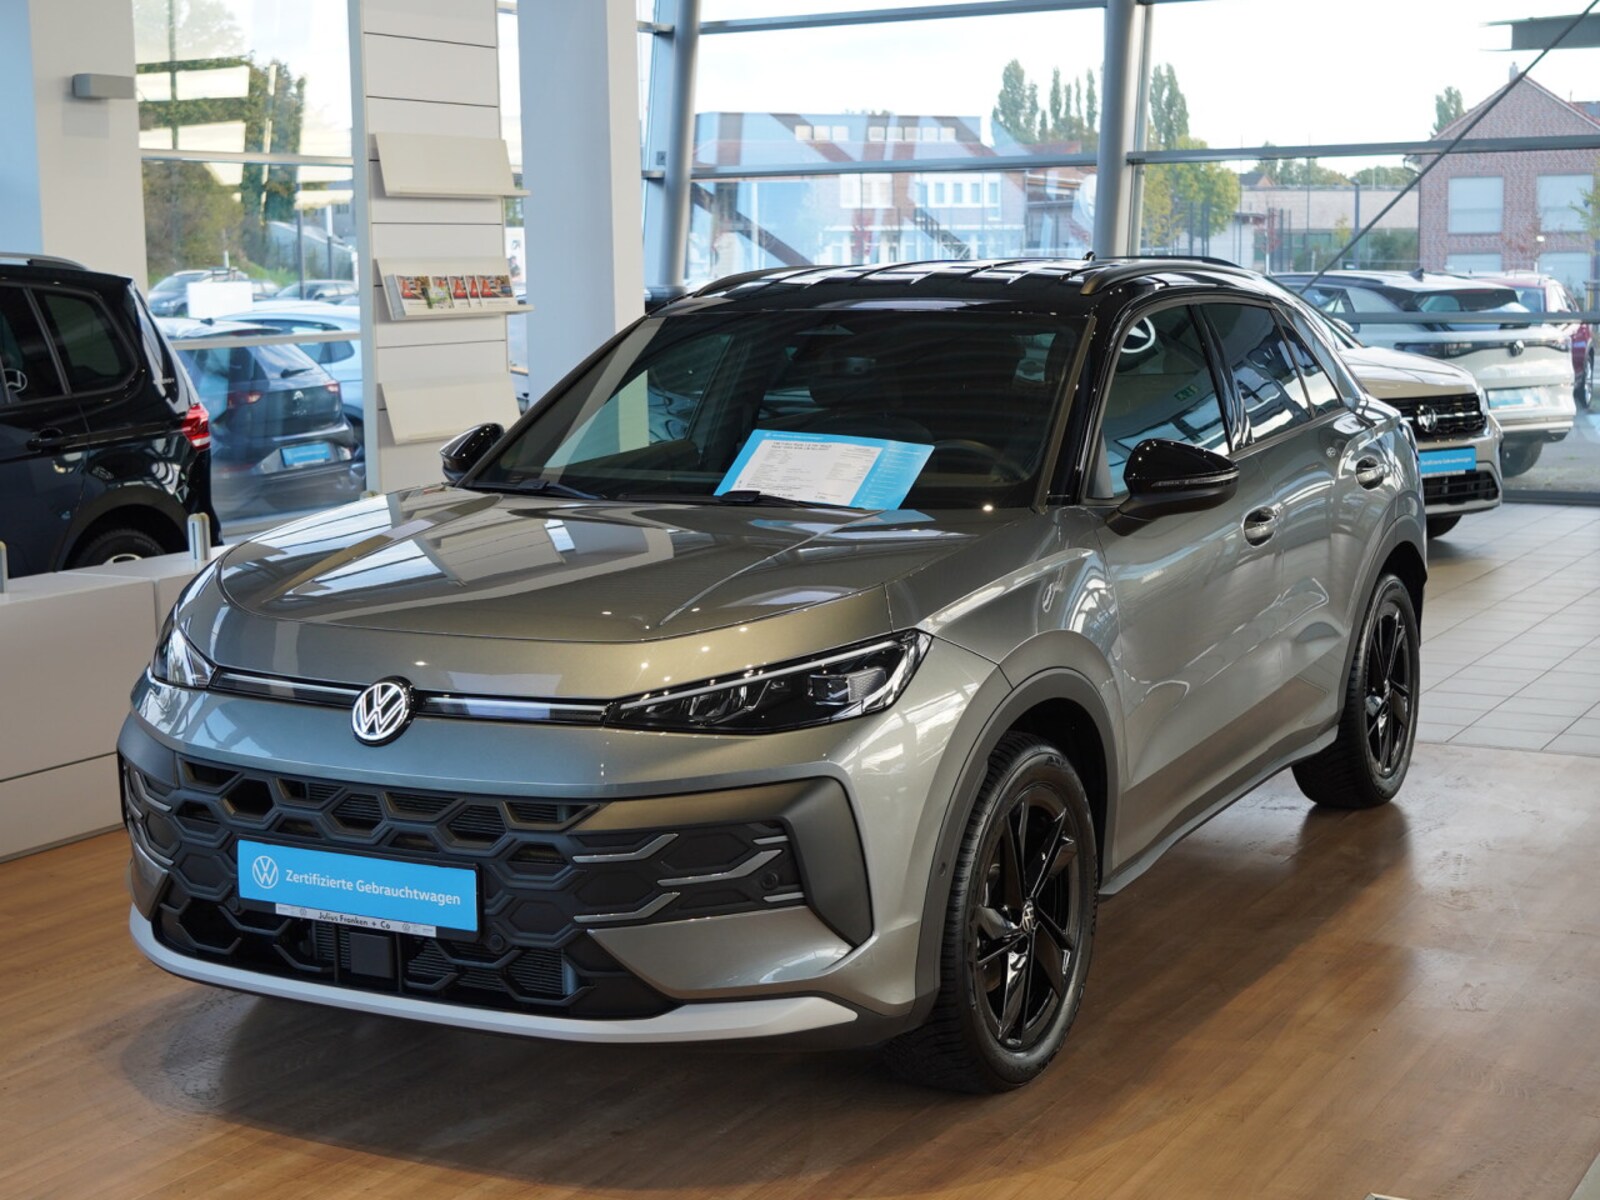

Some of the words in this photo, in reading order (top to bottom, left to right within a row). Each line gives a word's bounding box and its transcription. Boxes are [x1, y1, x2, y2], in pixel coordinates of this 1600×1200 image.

[285, 869, 354, 891] Zertifizierte
[355, 880, 461, 906] Gebrauchtwagen
[318, 912, 338, 922] Julius
[339, 914, 369, 926] Franken
[380, 920, 391, 930] Co
